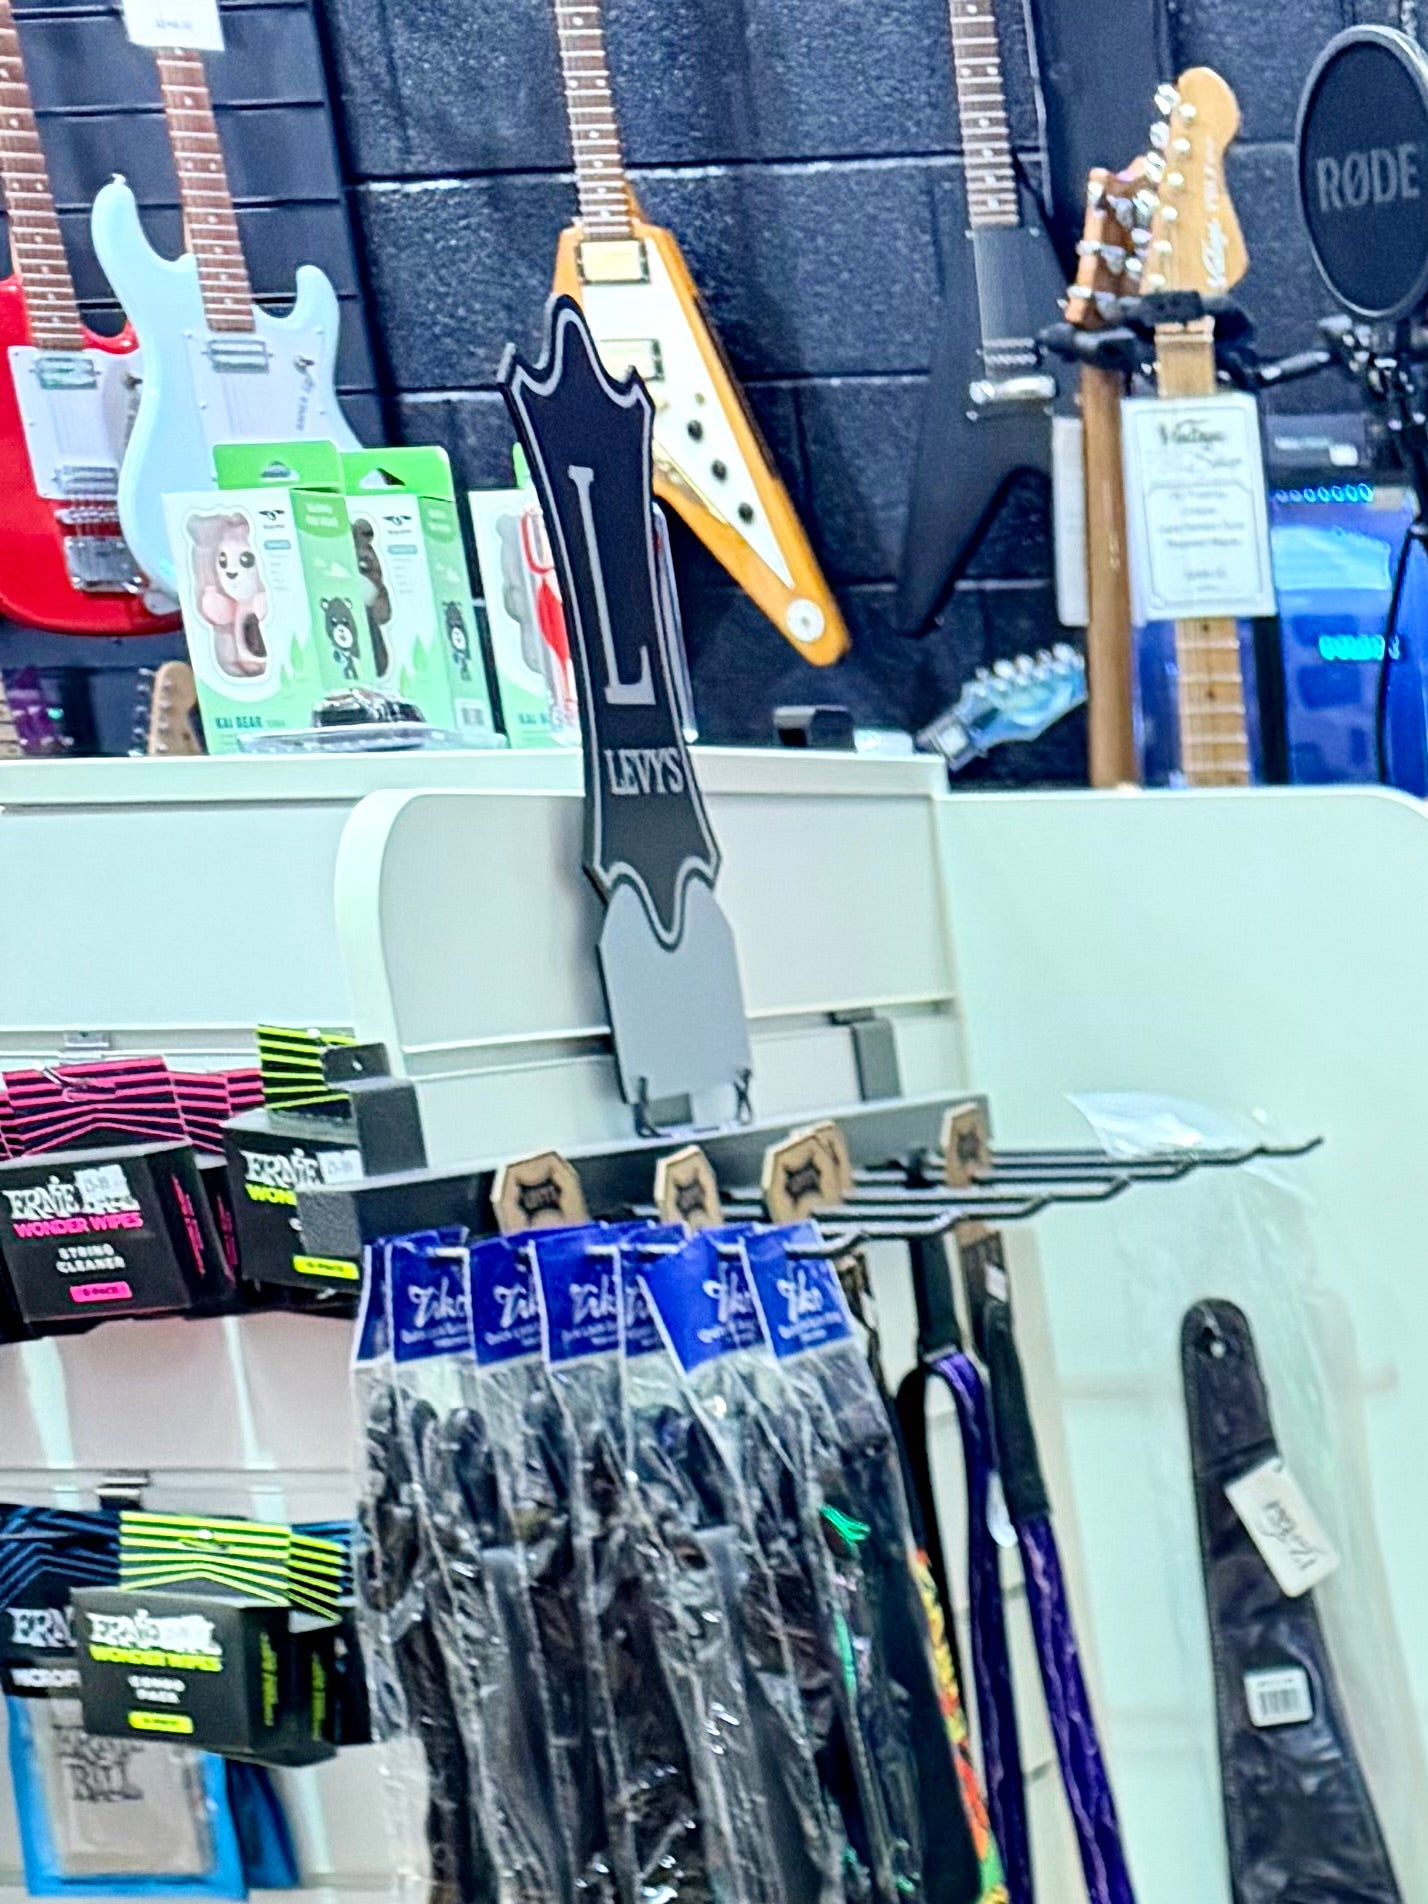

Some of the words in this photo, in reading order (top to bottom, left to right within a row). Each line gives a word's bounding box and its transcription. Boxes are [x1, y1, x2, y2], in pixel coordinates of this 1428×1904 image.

[1315, 143, 1420, 213] RØDE
[568, 464, 656, 705] L
[603, 747, 684, 794] LEVYS
[13, 1218, 90, 1239] WONDER
[90, 1212, 144, 1231] WIPES
[56, 1256, 126, 1273] CLEANER
[6, 1606, 77, 1648] ERN
